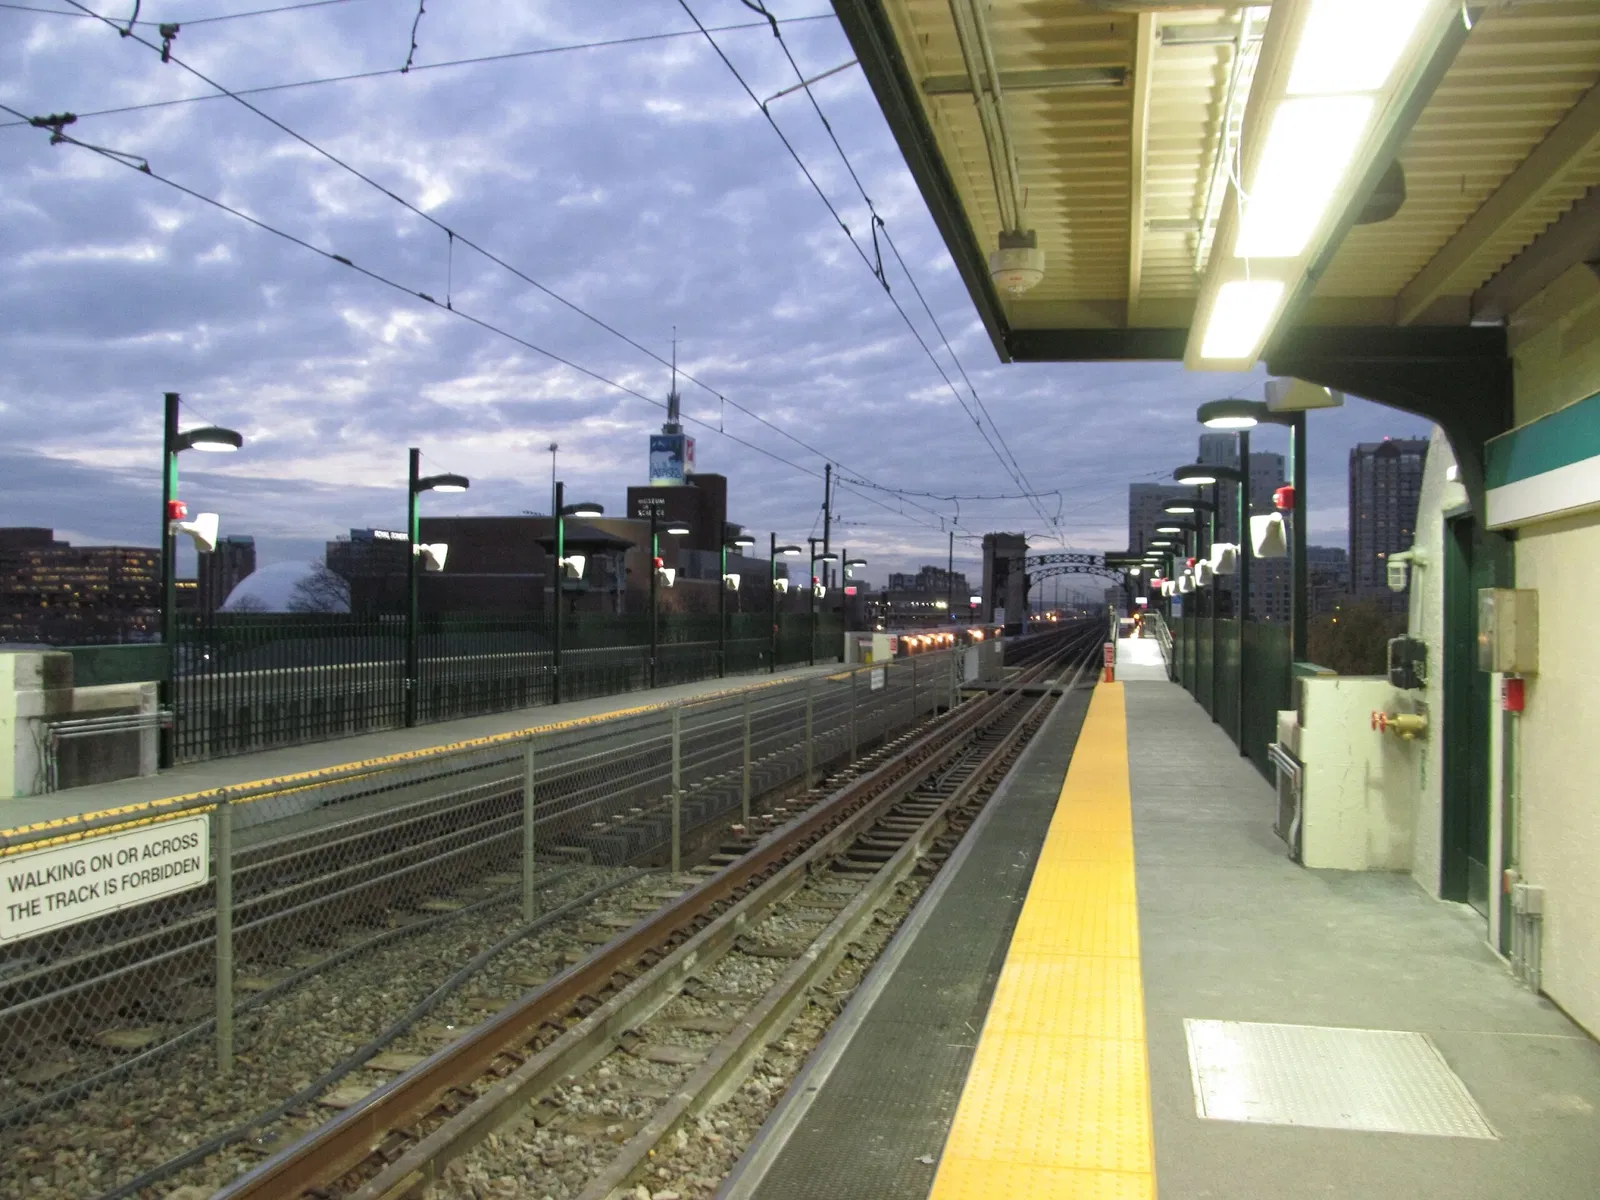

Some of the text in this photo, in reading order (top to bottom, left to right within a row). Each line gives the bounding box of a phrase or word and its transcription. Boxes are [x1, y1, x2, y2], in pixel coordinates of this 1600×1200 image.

[7, 832, 199, 893] WALKING ON OR ACROSS
[7, 856, 200, 922] THE TRACK IS FORBIDDEN
